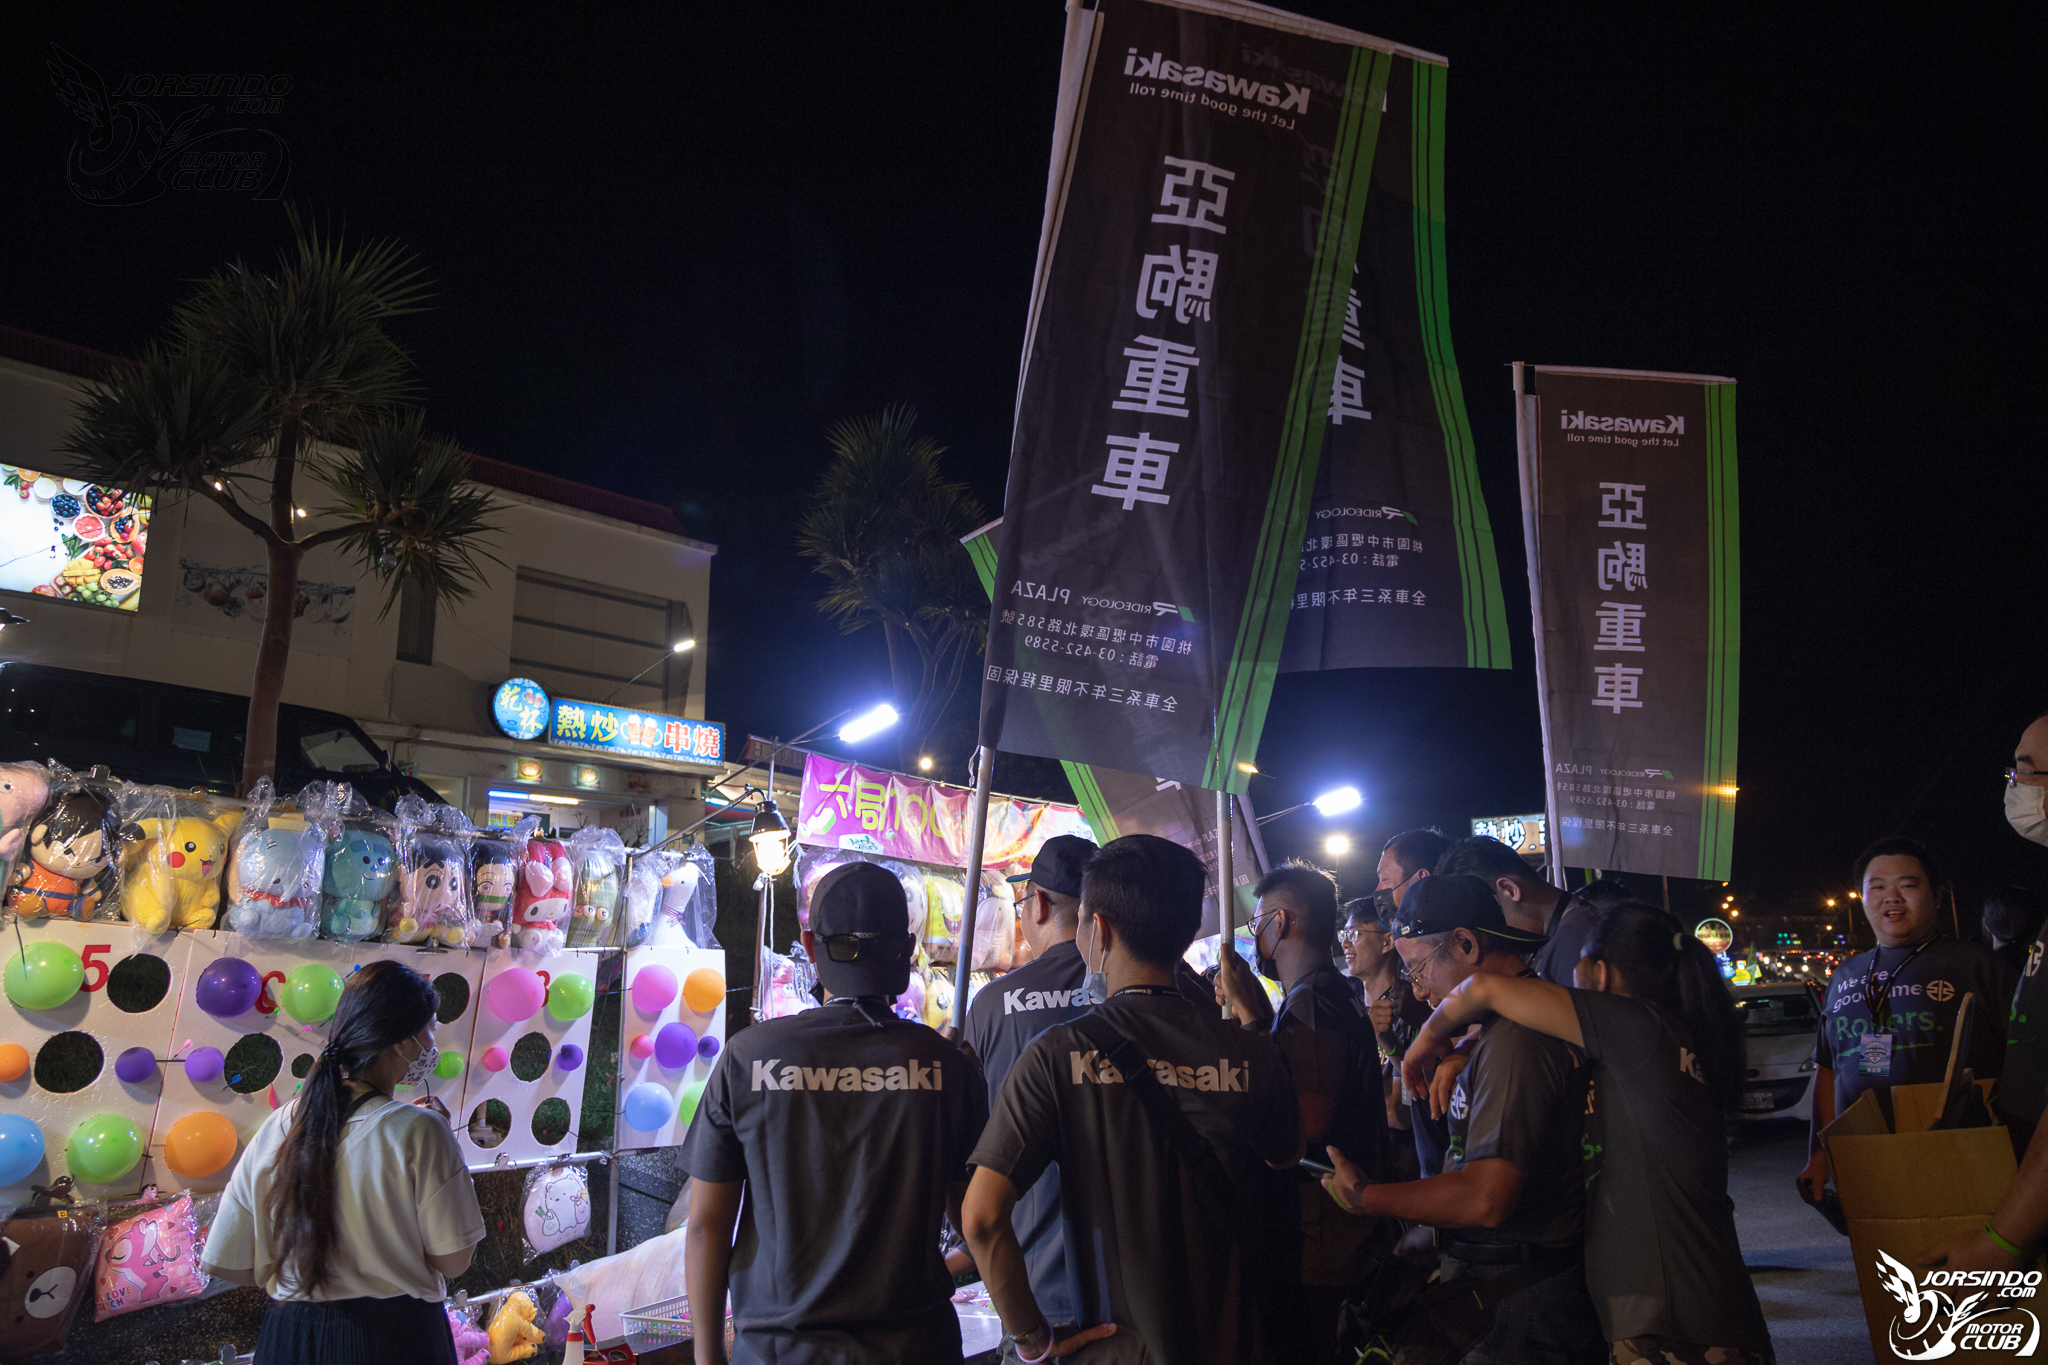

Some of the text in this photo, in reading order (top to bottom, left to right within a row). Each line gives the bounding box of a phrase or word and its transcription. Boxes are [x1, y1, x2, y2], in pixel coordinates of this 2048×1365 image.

[500, 684, 543, 733] 乾杯
[556, 705, 619, 742] 熱炒
[664, 721, 721, 759] 串燒
[1003, 987, 1105, 1016] Kawas
[1837, 977, 1859, 994] We
[750, 1058, 942, 1093] Kawasaki
[1069, 1050, 1249, 1093] Kaasaki
[107, 1286, 132, 1300] LOVE
